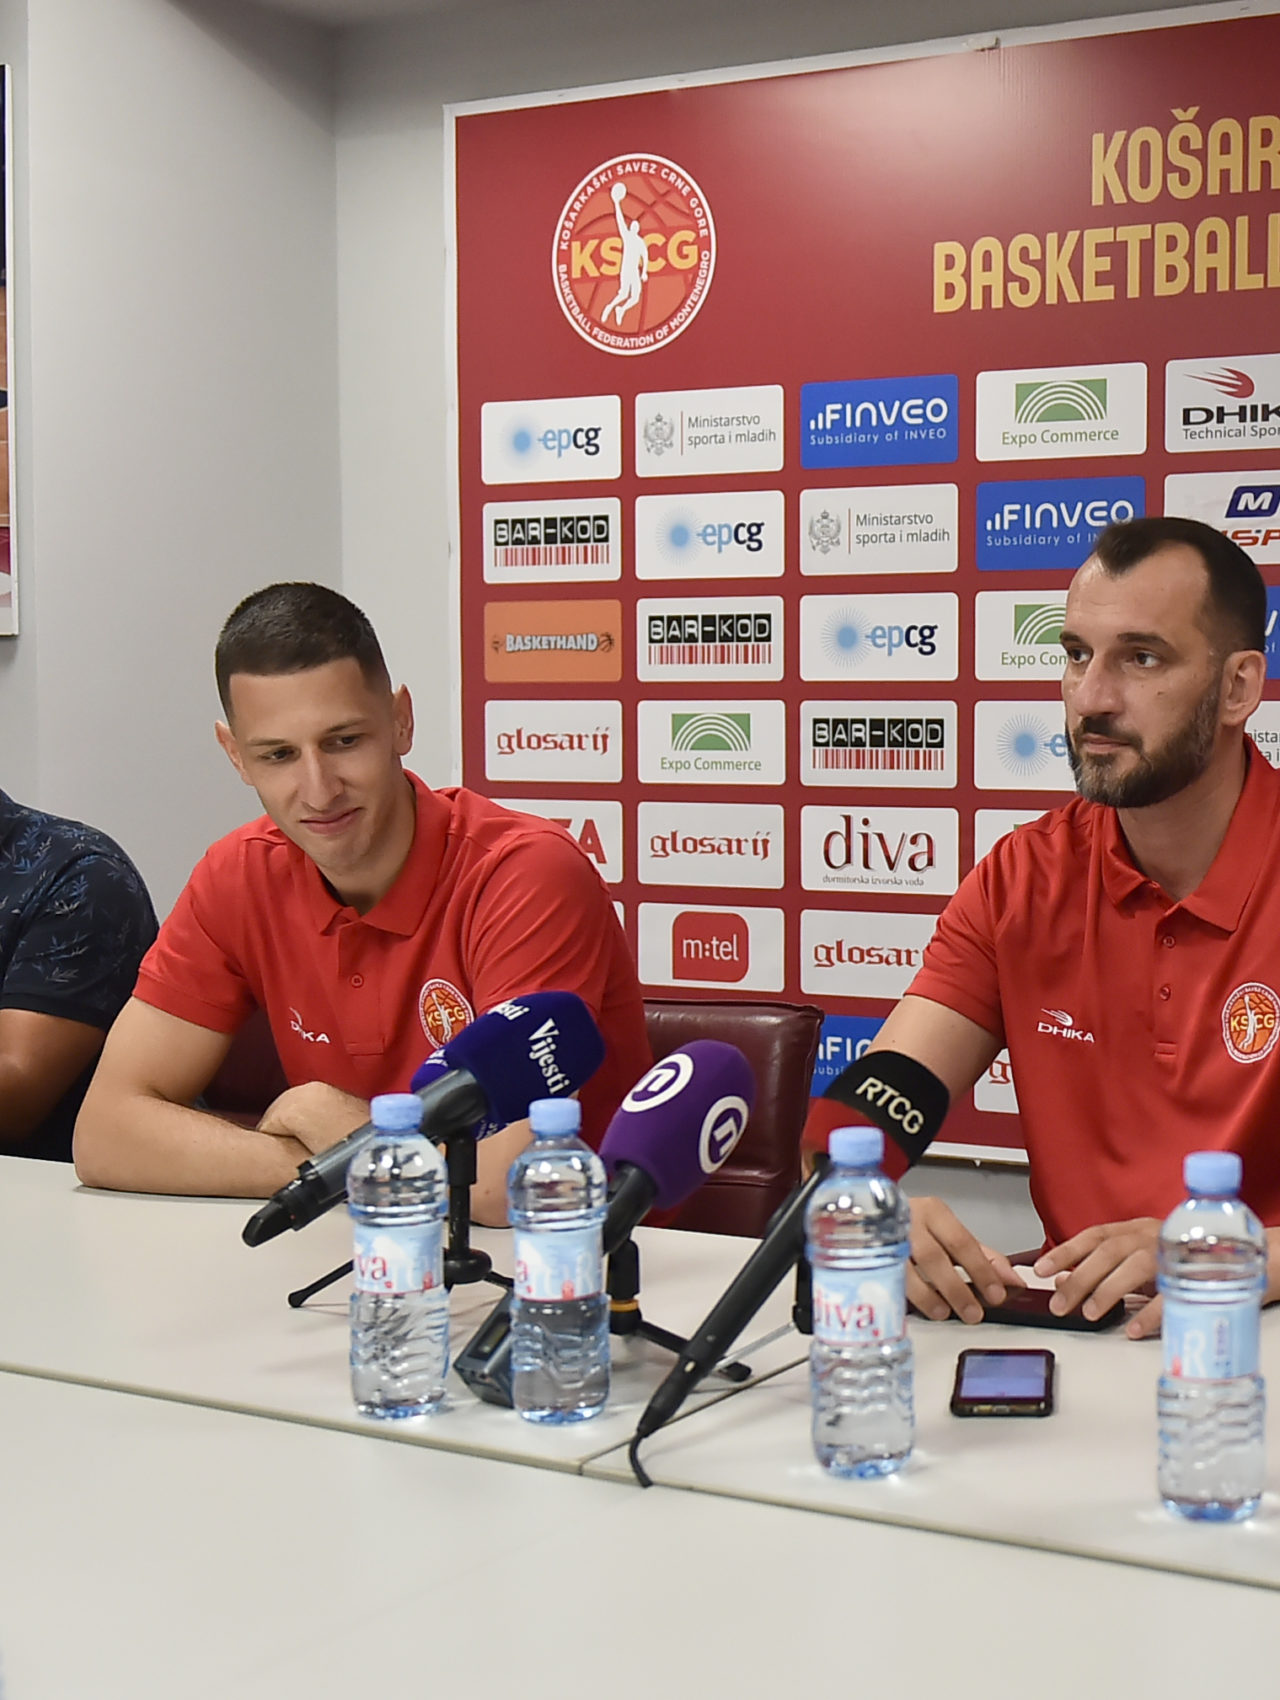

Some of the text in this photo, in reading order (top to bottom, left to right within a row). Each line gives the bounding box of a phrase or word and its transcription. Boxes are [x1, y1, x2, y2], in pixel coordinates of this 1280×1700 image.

[560, 162, 709, 250] KOŠARKAŠKI SAVEZ CRNE GORE
[558, 250, 711, 348] BASKETBALL FEDERATION OF MONTENEGRO
[688, 412, 760, 429] Ministarstvo
[826, 397, 948, 429] FINVEO
[541, 425, 602, 458] epcg
[688, 428, 726, 448] sporta
[735, 427, 776, 443] mladih
[810, 428, 946, 447] Subsidiary of INVEO
[1002, 427, 1119, 448] Expo Commerce
[1182, 424, 1247, 441] Technical
[856, 511, 934, 527] Ministarstvo
[1003, 500, 1134, 530] FINVEO
[494, 514, 609, 546] BAR-KOD
[700, 521, 765, 553] epcg
[856, 530, 895, 546] sporta
[907, 528, 950, 543] mladih
[986, 534, 1060, 547] Subsidiary
[1067, 533, 1080, 544] of
[506, 632, 598, 653] BASKETHAND
[648, 613, 772, 643] BAR-KOD
[870, 624, 938, 656] epcg
[1001, 652, 1036, 668] Expo
[497, 727, 610, 755] glosarij
[812, 718, 944, 748] BAR-KOD
[660, 757, 762, 772] Expo Commerce
[650, 830, 771, 861] glosarij
[823, 814, 936, 873] diva
[682, 934, 739, 962] m:tel
[814, 939, 919, 968] glosar
[1037, 1021, 1095, 1043] DHIKA
[528, 1018, 570, 1095] Vijesti
[855, 1076, 924, 1135] RTCG
